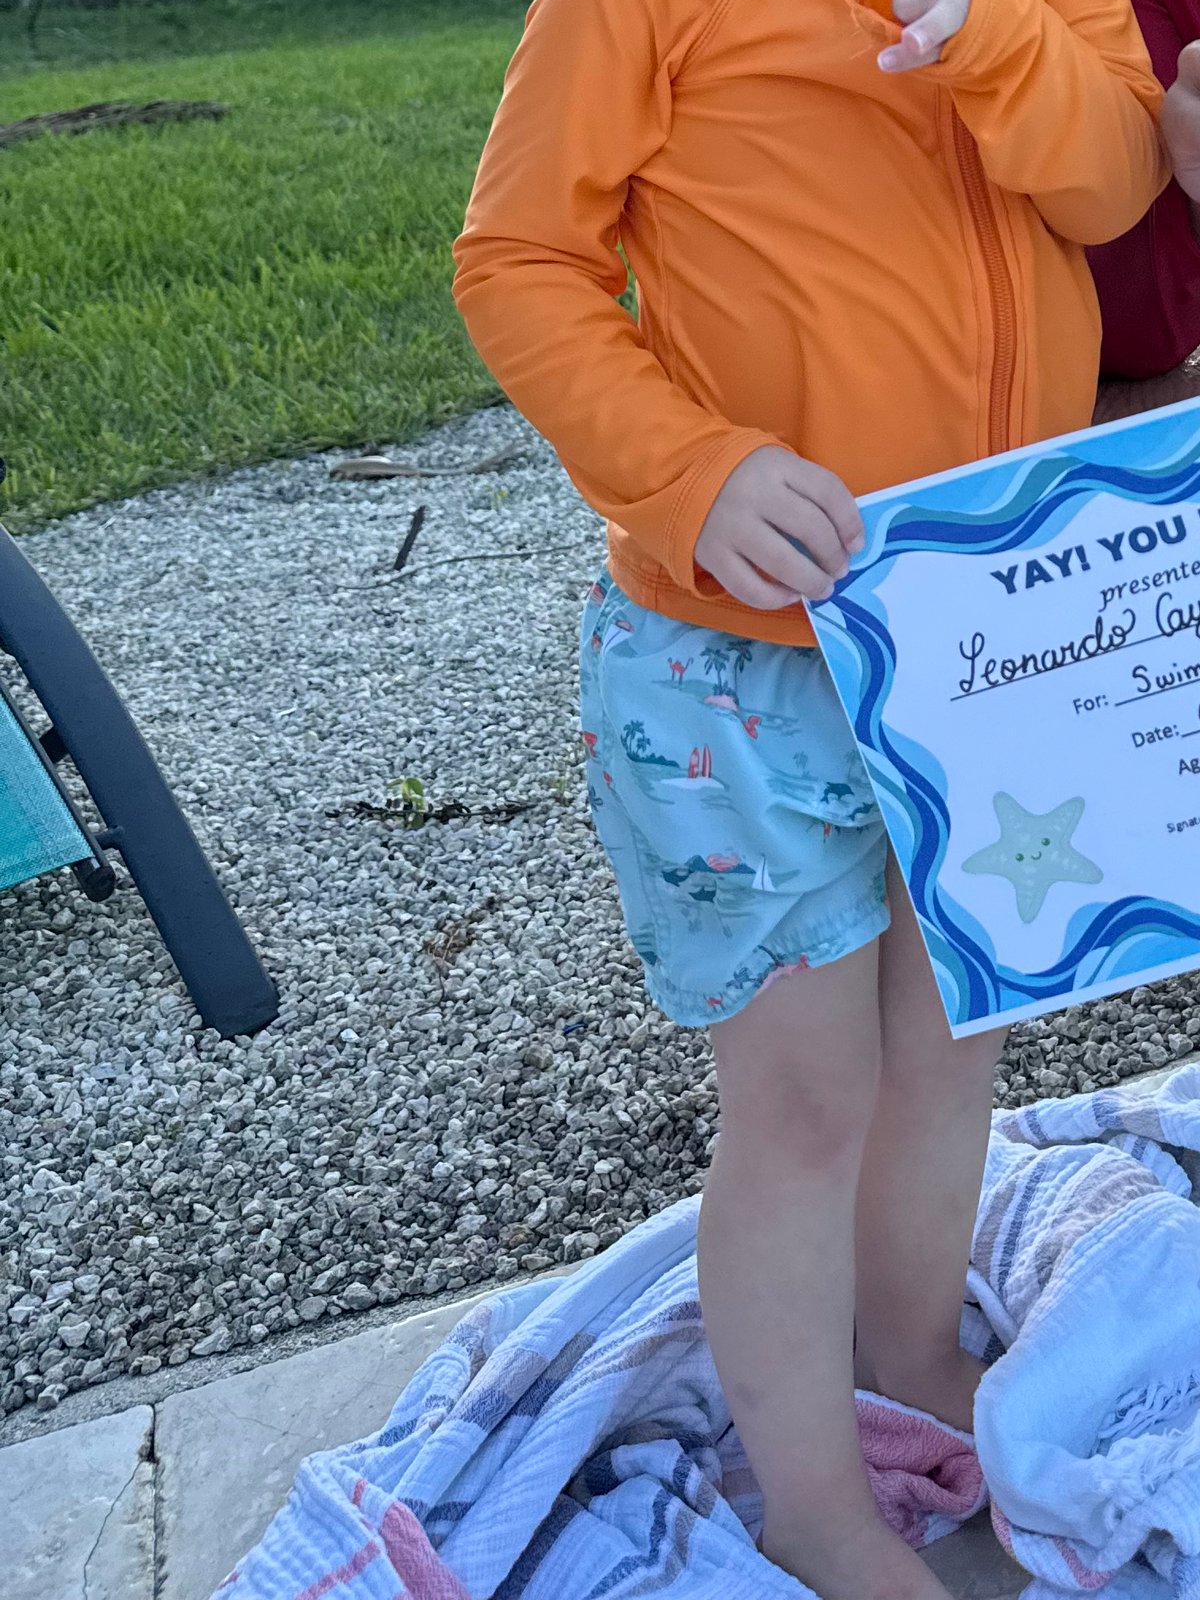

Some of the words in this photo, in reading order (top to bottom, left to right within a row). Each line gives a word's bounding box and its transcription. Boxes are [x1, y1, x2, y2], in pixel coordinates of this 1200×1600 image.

[990, 545, 1091, 595] YAY!
[1096, 515, 1187, 562] YOU
[959, 608, 1136, 692] Leonardo
[1072, 694, 1108, 715] For:
[1131, 724, 1180, 748] Date:
